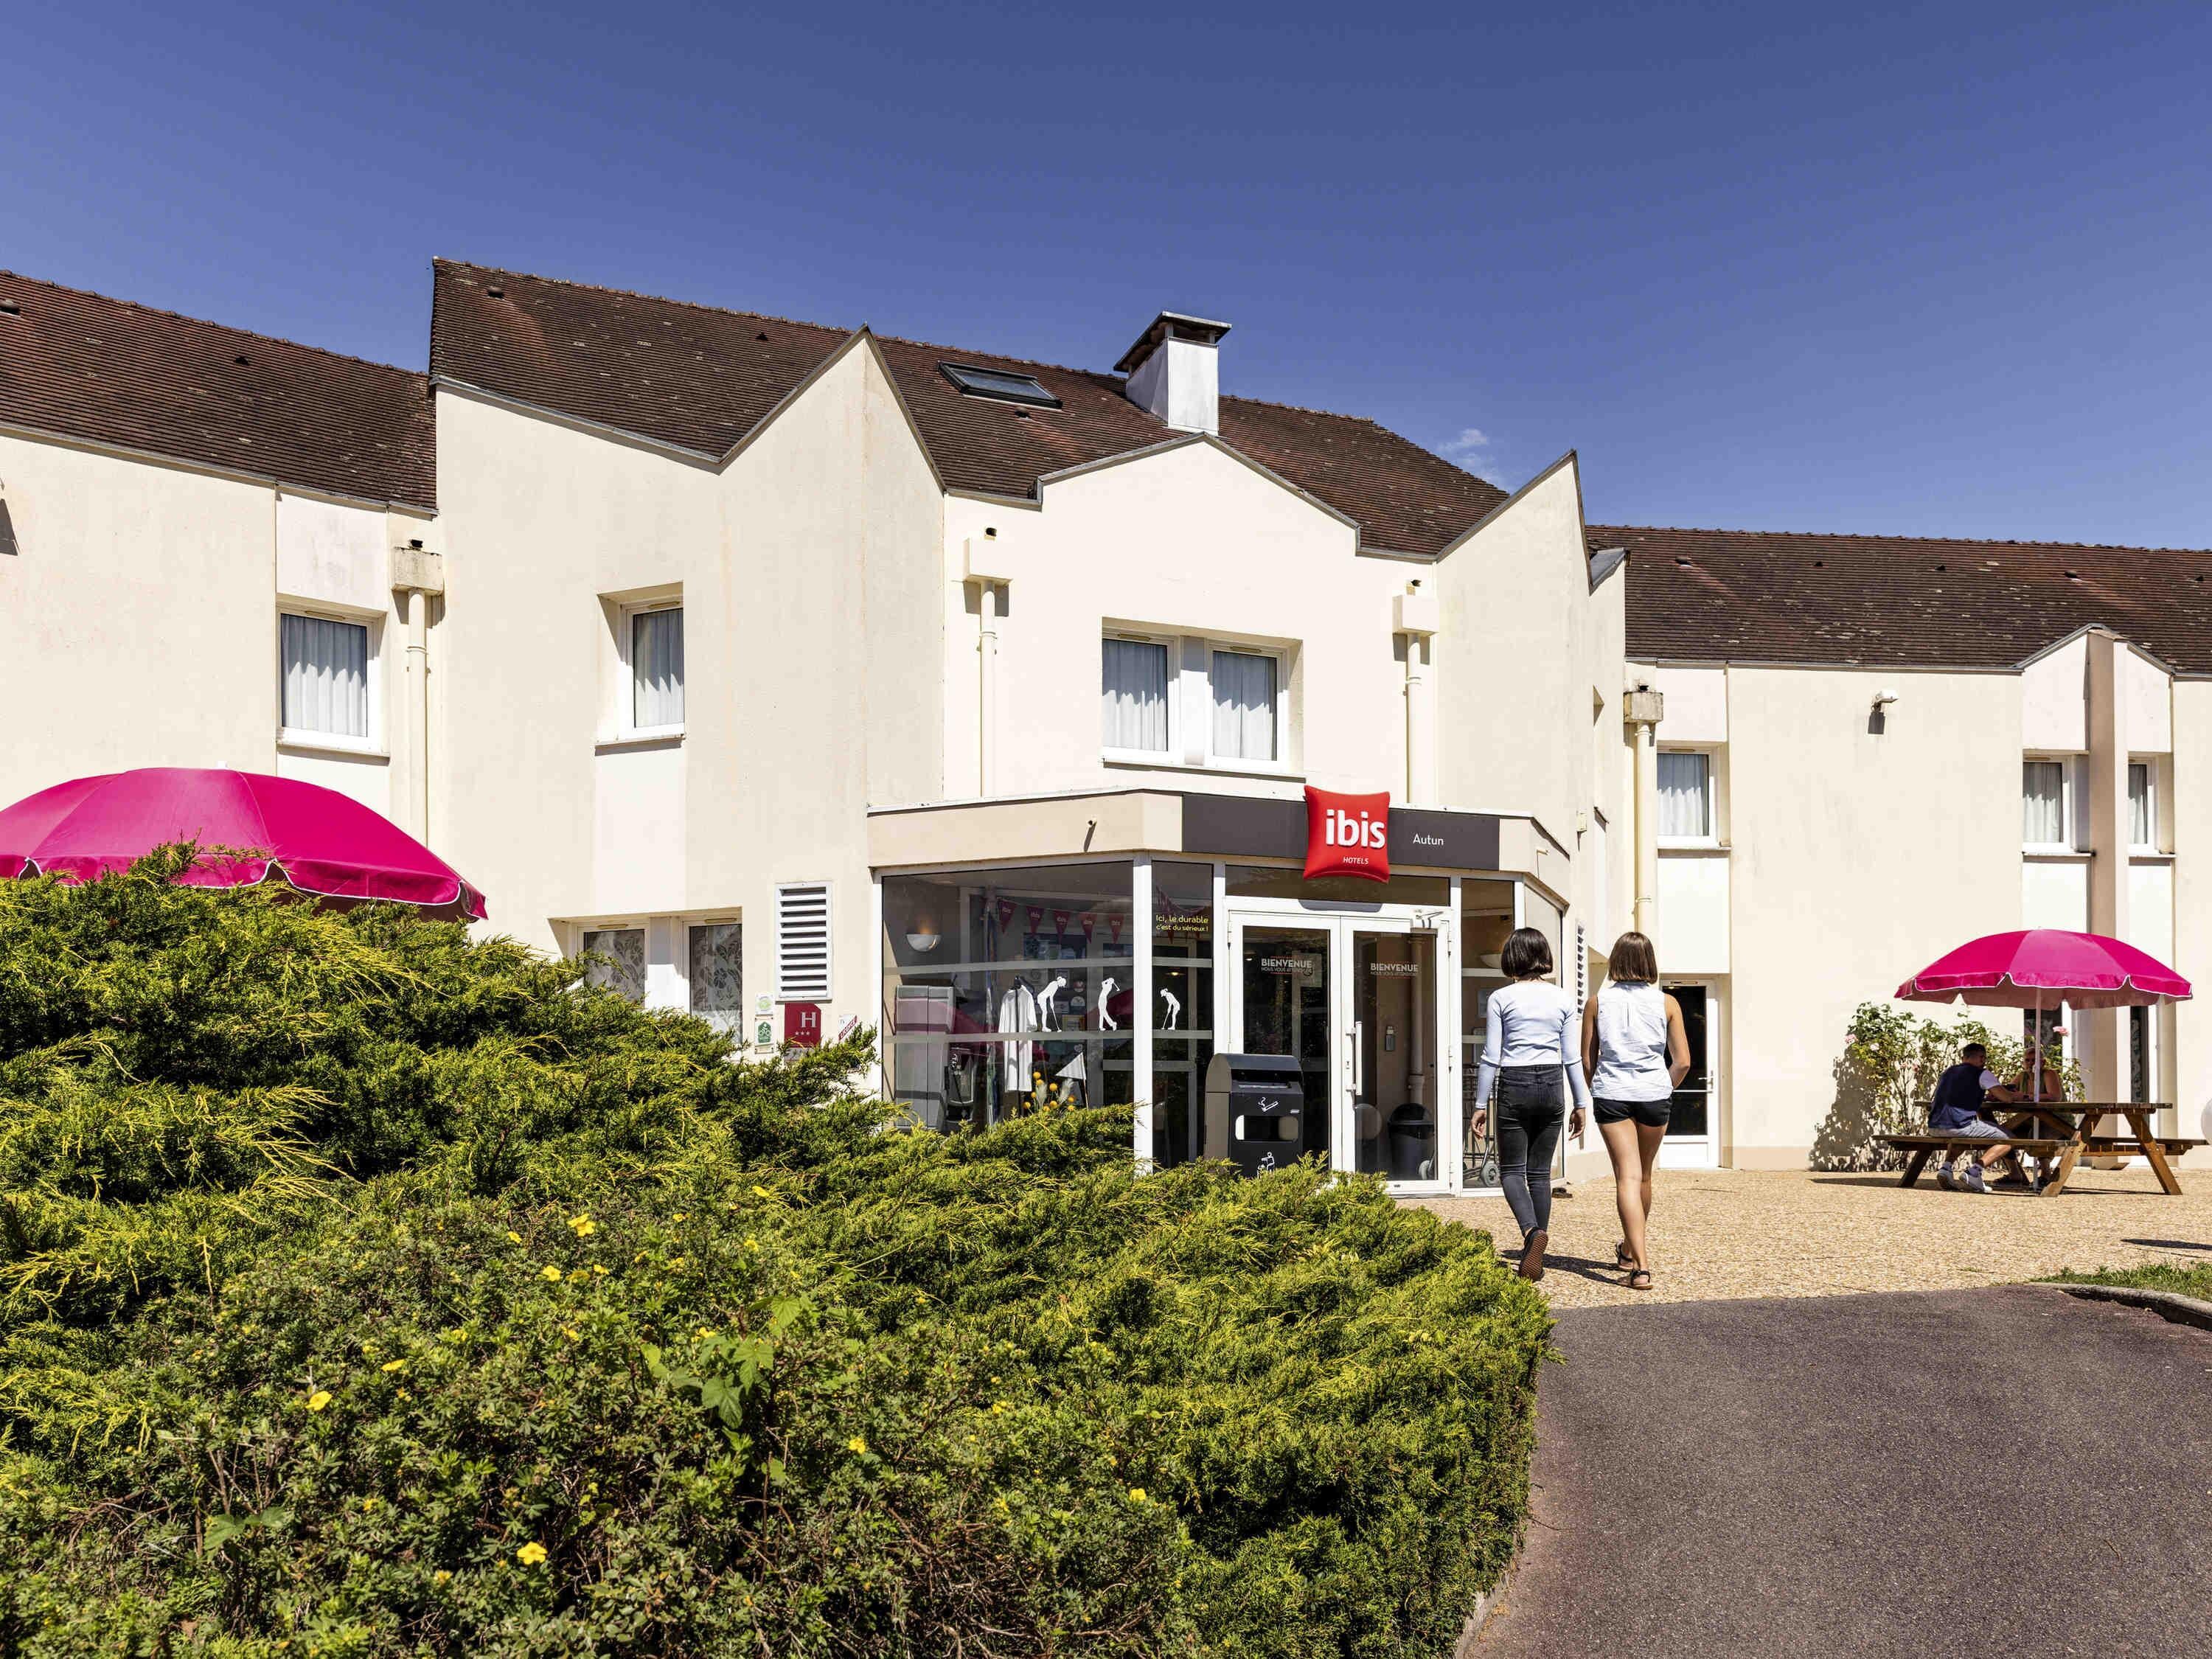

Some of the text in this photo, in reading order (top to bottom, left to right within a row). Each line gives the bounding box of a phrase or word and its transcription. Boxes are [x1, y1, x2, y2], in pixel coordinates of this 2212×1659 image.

[1326, 810, 1385, 848] ibis
[1413, 834, 1444, 846] Autun
[1343, 857, 1368, 865] HOTELS
[1156, 914, 1167, 923] Ici,
[1178, 915, 1208, 924] durable
[1261, 958, 1312, 968] BIENVENUE
[1370, 962, 1419, 972] BIENVENUE
[801, 1012, 816, 1028] H
